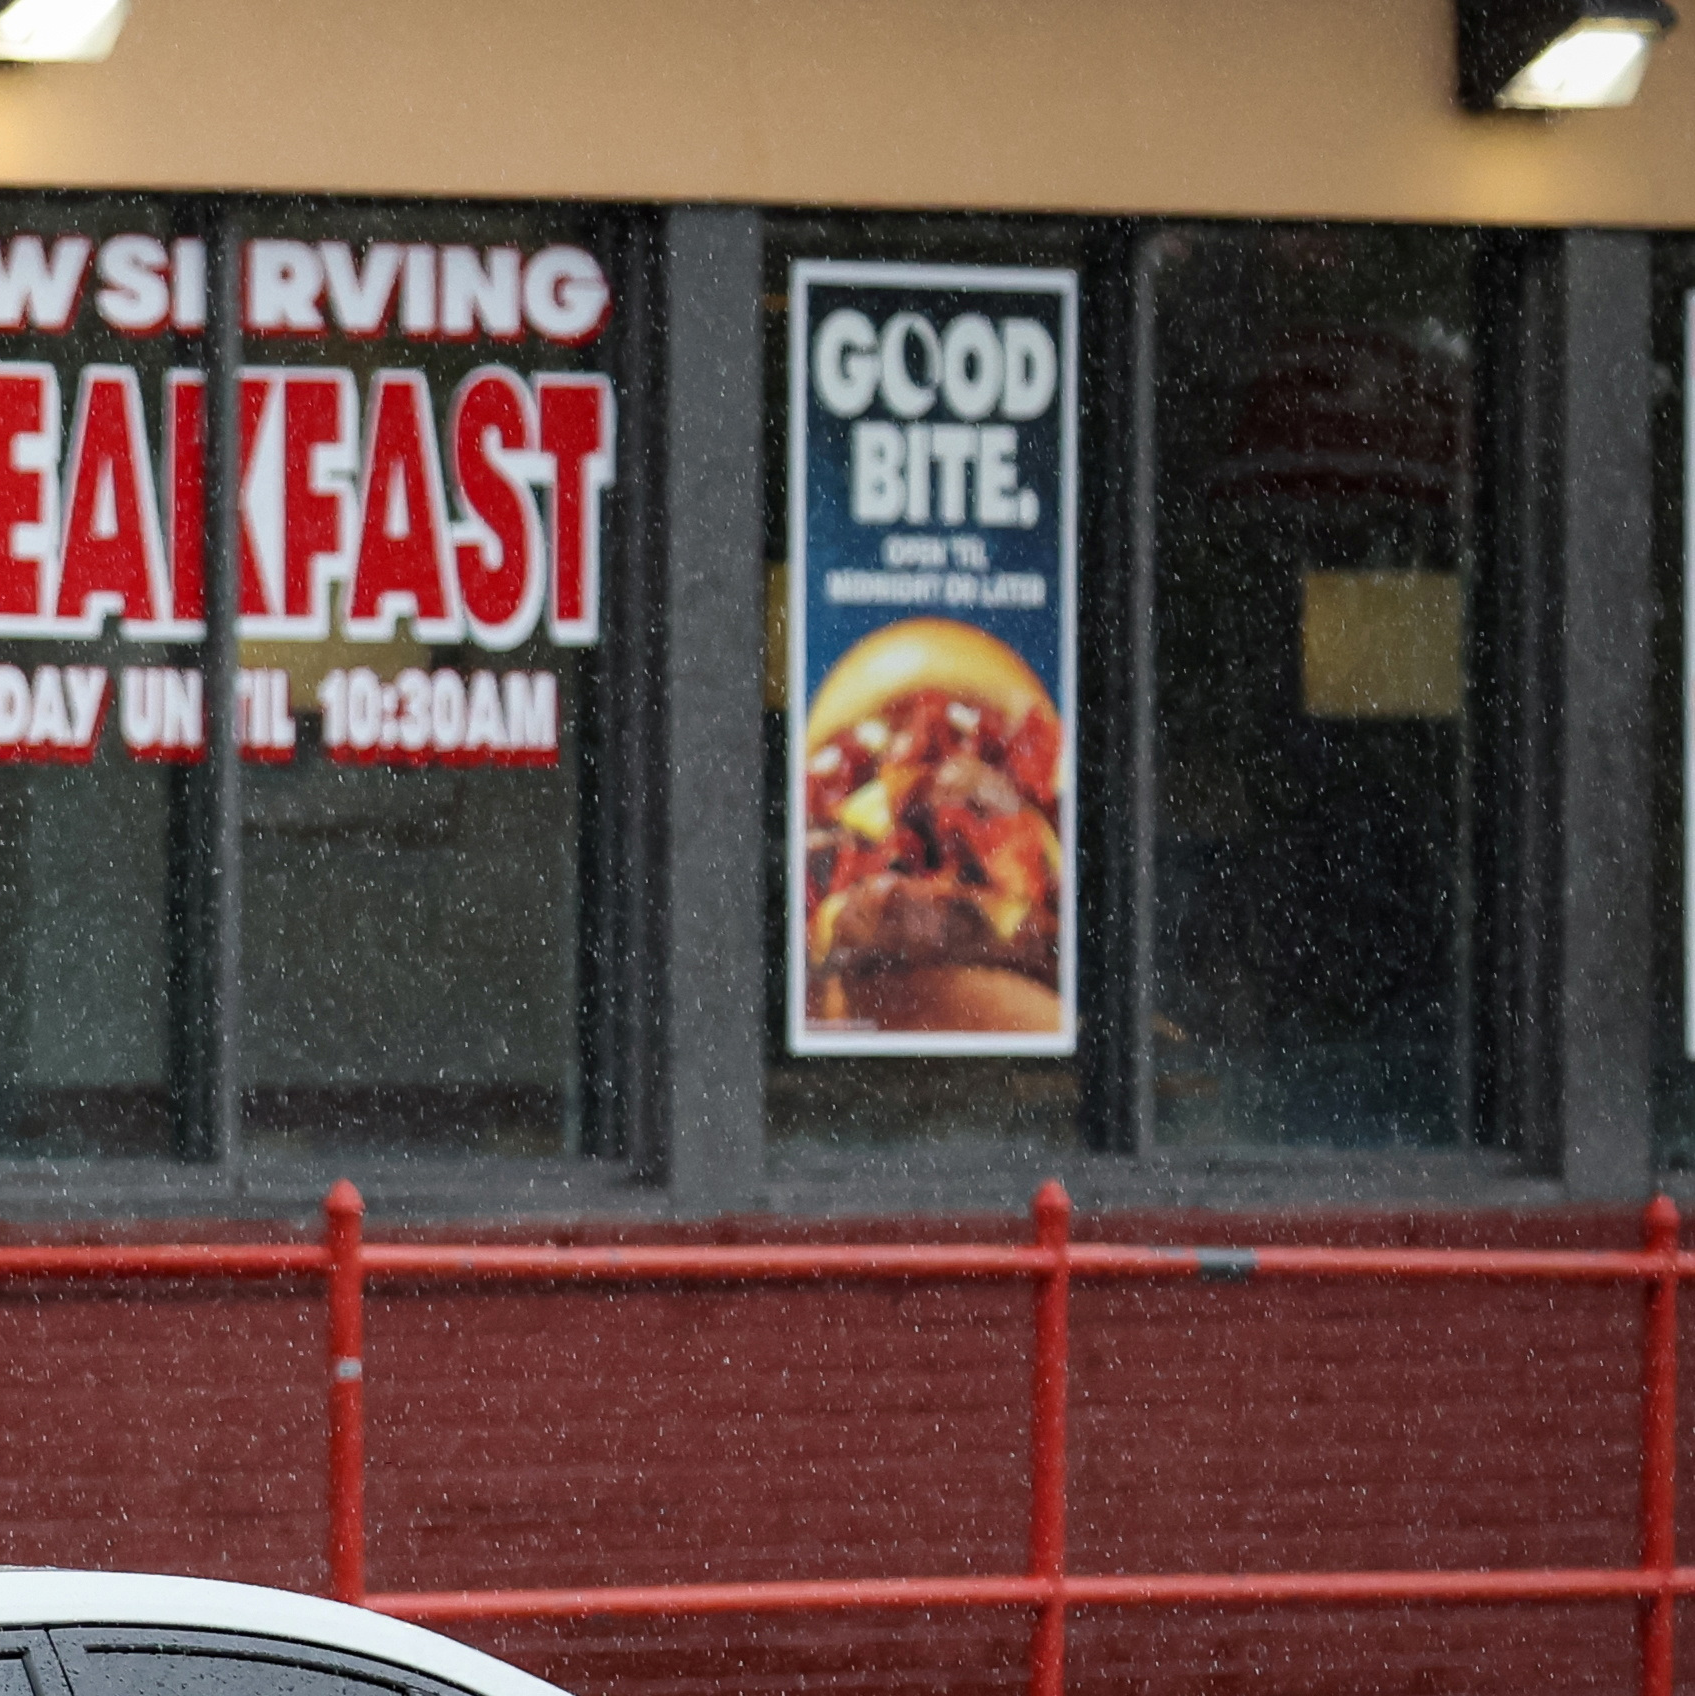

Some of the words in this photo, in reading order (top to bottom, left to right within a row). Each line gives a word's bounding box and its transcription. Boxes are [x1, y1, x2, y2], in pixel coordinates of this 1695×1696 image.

[813, 307, 1058, 421] GOOD
[848, 420, 1040, 530] BITE.
[316, 664, 560, 769] 10:30AM
